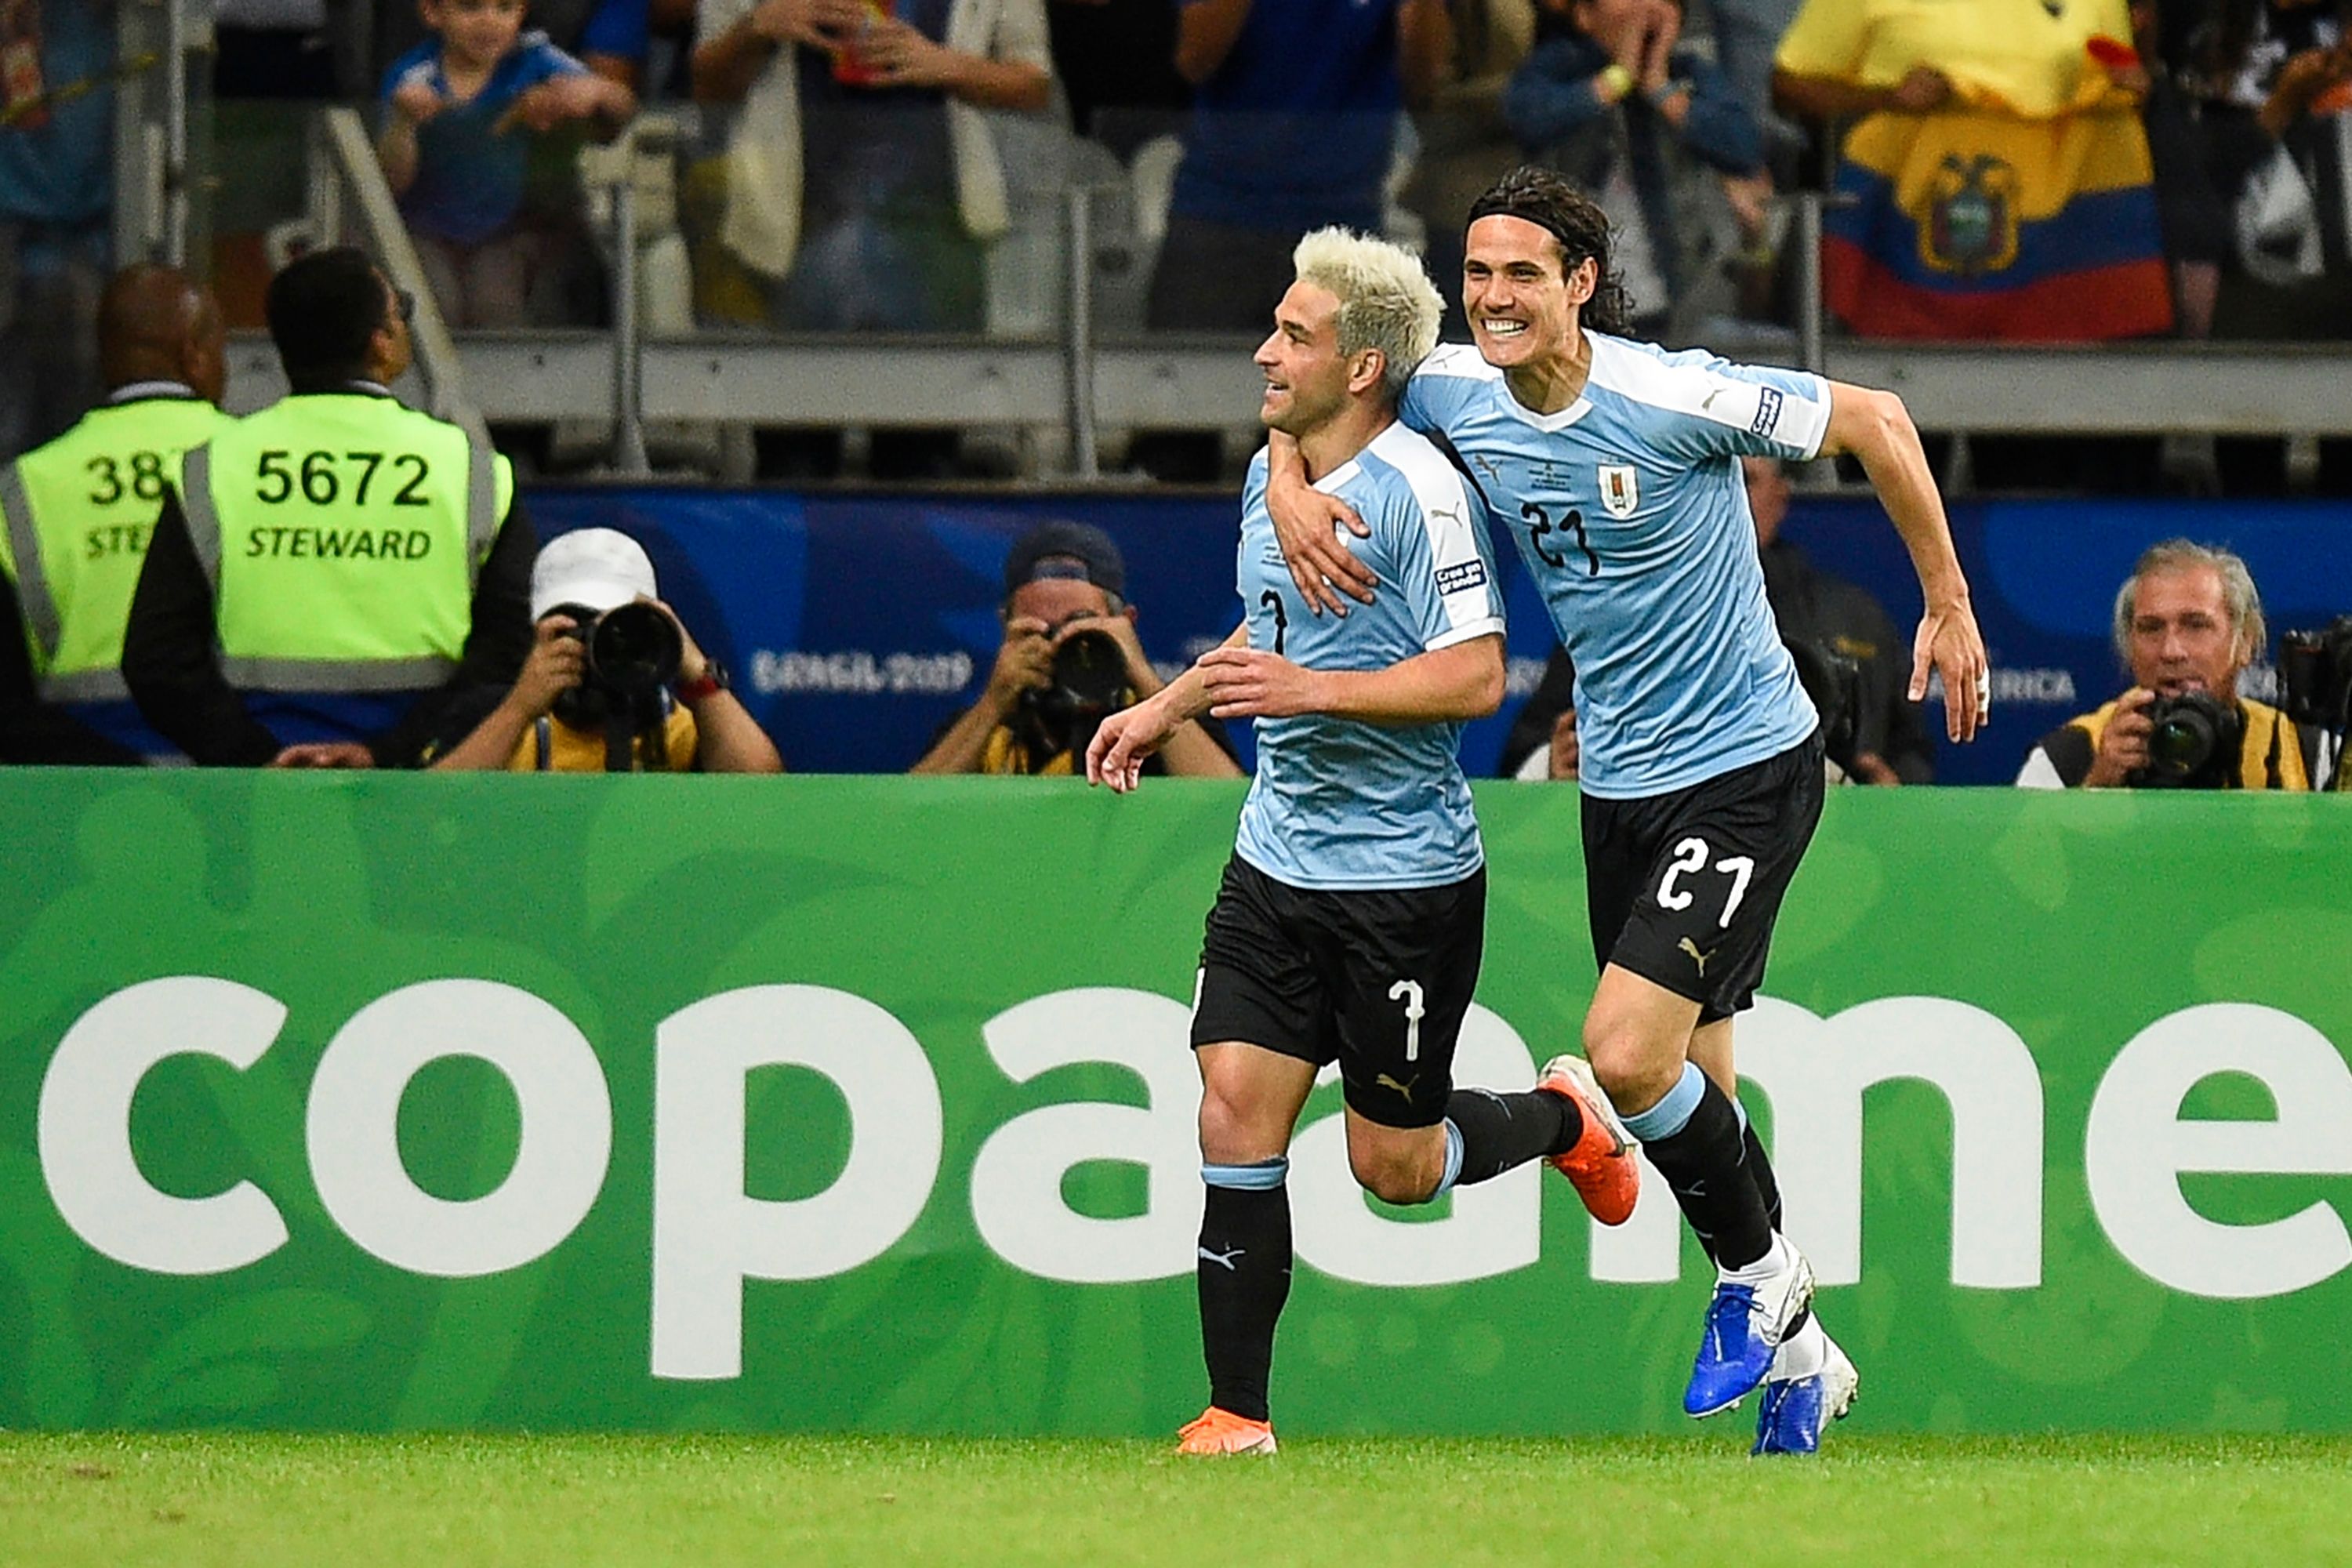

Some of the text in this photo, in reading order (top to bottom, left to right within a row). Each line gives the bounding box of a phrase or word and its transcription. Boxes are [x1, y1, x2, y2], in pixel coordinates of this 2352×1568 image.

[256, 450, 430, 506] 5672
[246, 526, 431, 560] STEWARD
[1521, 502, 1600, 577] 21
[1658, 837, 1755, 928] 21
[1388, 978, 1426, 1062] 7
